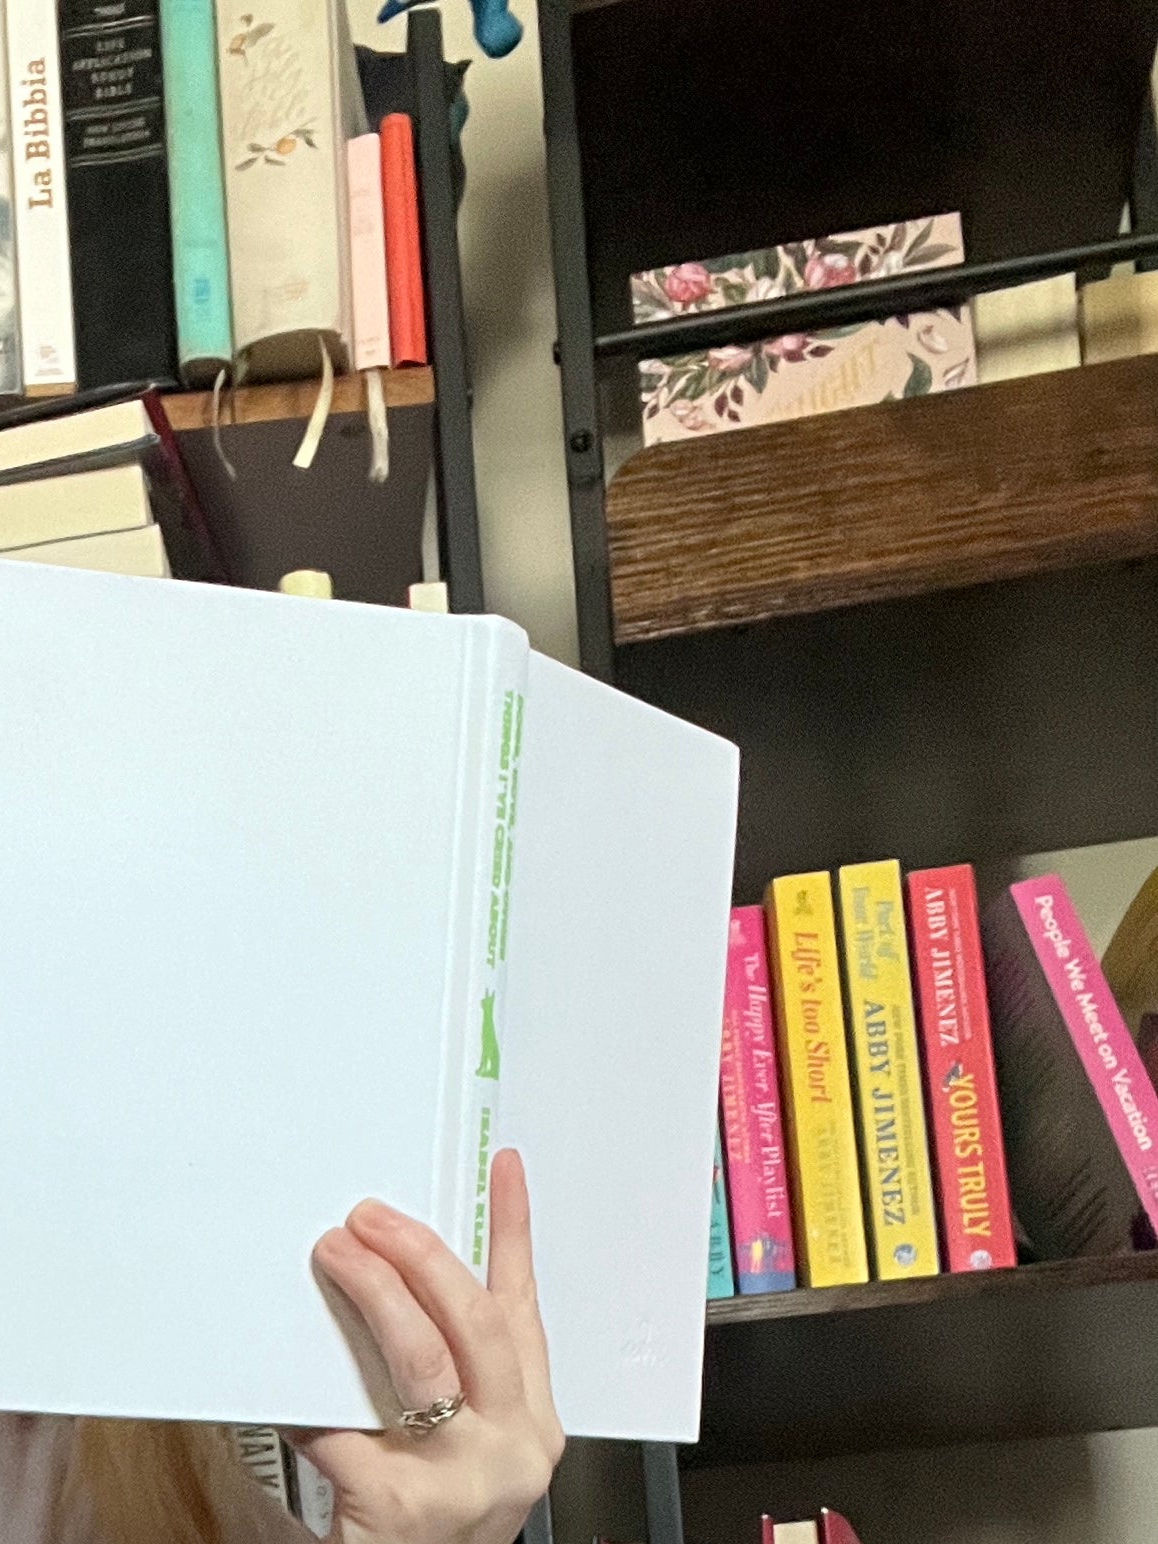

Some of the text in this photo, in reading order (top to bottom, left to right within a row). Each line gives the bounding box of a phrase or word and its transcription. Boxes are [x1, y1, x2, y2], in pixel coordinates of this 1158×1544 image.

[22, 56, 54, 210] La Bibbia
[487, 690, 514, 969] THINGS I'VE CRIED ABOUT
[791, 931, 833, 1105] Life's too Short
[924, 886, 960, 1048] ABBY JIMENEZ
[1035, 894, 1070, 958] People
[1064, 958, 1086, 992] We
[1076, 992, 1108, 1043] Meet
[1098, 1043, 1118, 1070] on
[1112, 1068, 1153, 1152] Vacation
[742, 952, 785, 1219] The Happy Ever After Playlist
[864, 999, 906, 1227] ABBY JIMENEZ
[949, 1073, 992, 1237] YOURS TRULY
[472, 1107, 491, 1266] ISABEL KLEE
